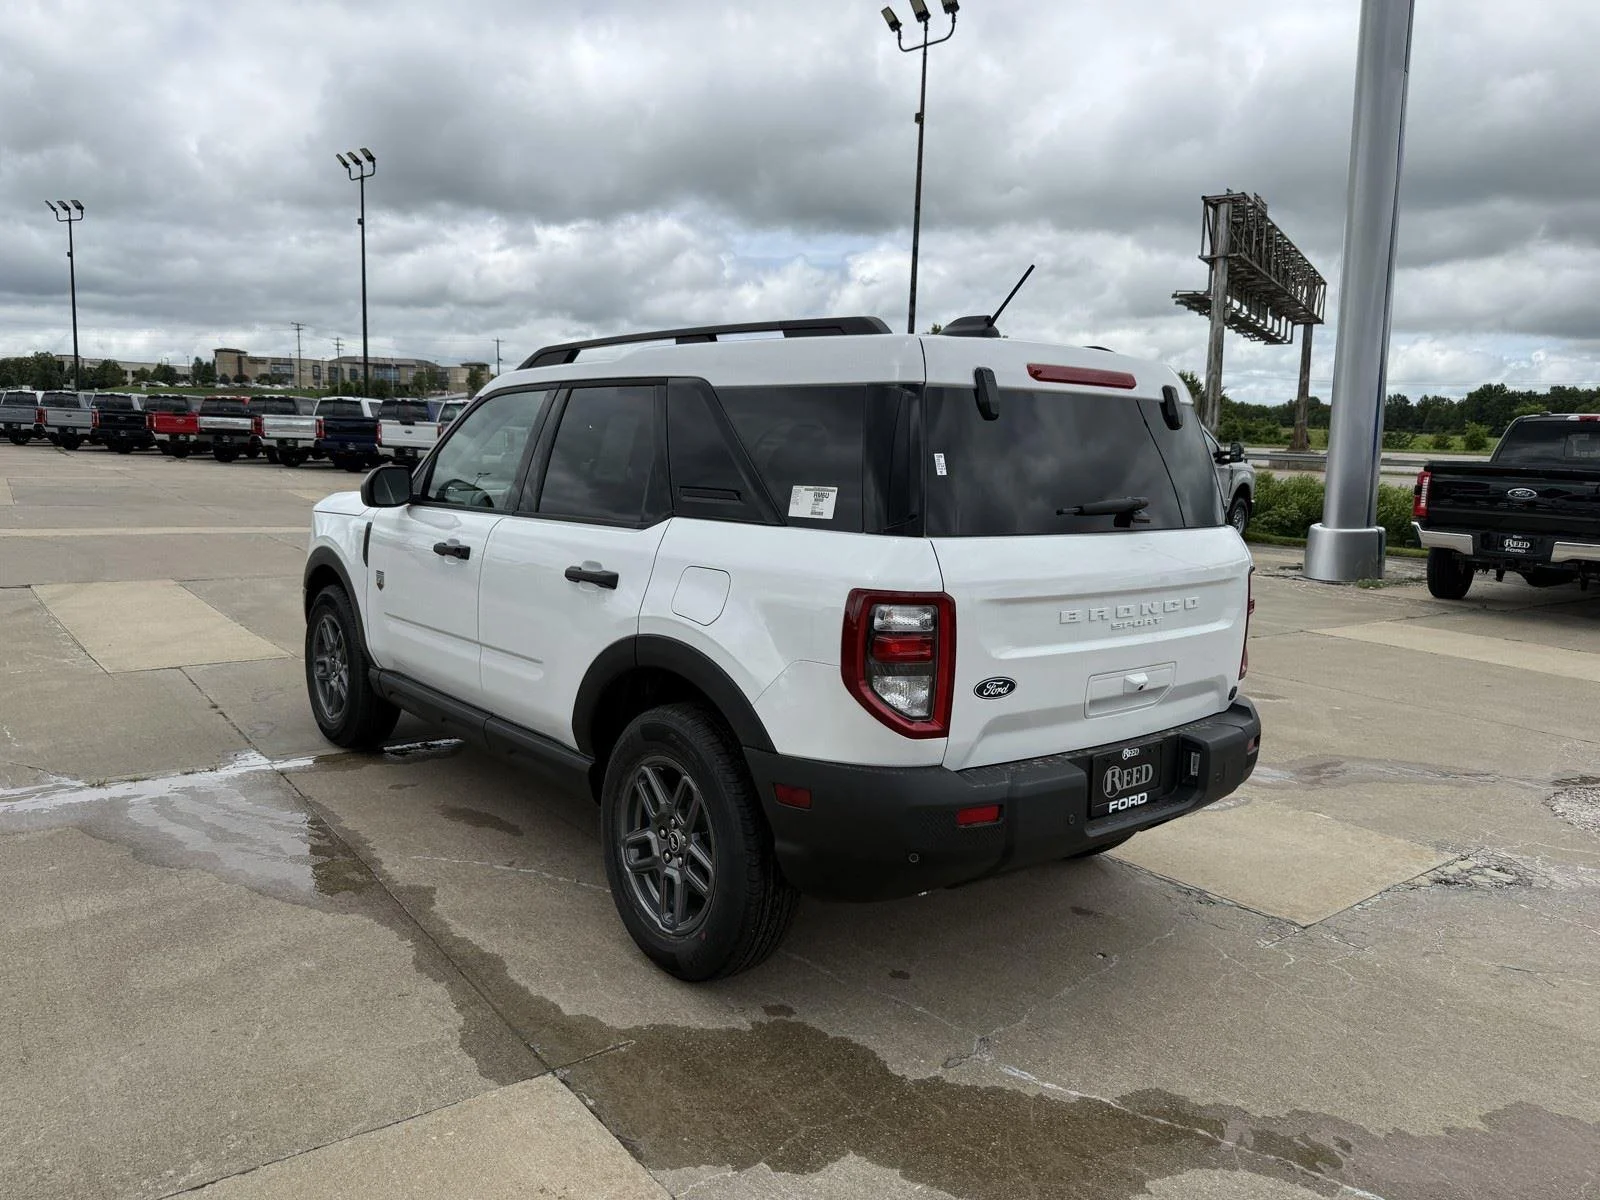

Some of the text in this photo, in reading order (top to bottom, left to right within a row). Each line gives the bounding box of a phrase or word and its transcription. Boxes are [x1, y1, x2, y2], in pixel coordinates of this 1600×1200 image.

[1504, 539, 1530, 549] REED
[1059, 596, 1200, 625] BRONCO
[1111, 616, 1164, 630] SPORT
[983, 681, 1010, 696] Ford
[1103, 764, 1153, 798] REED
[1109, 792, 1148, 813] FORD
